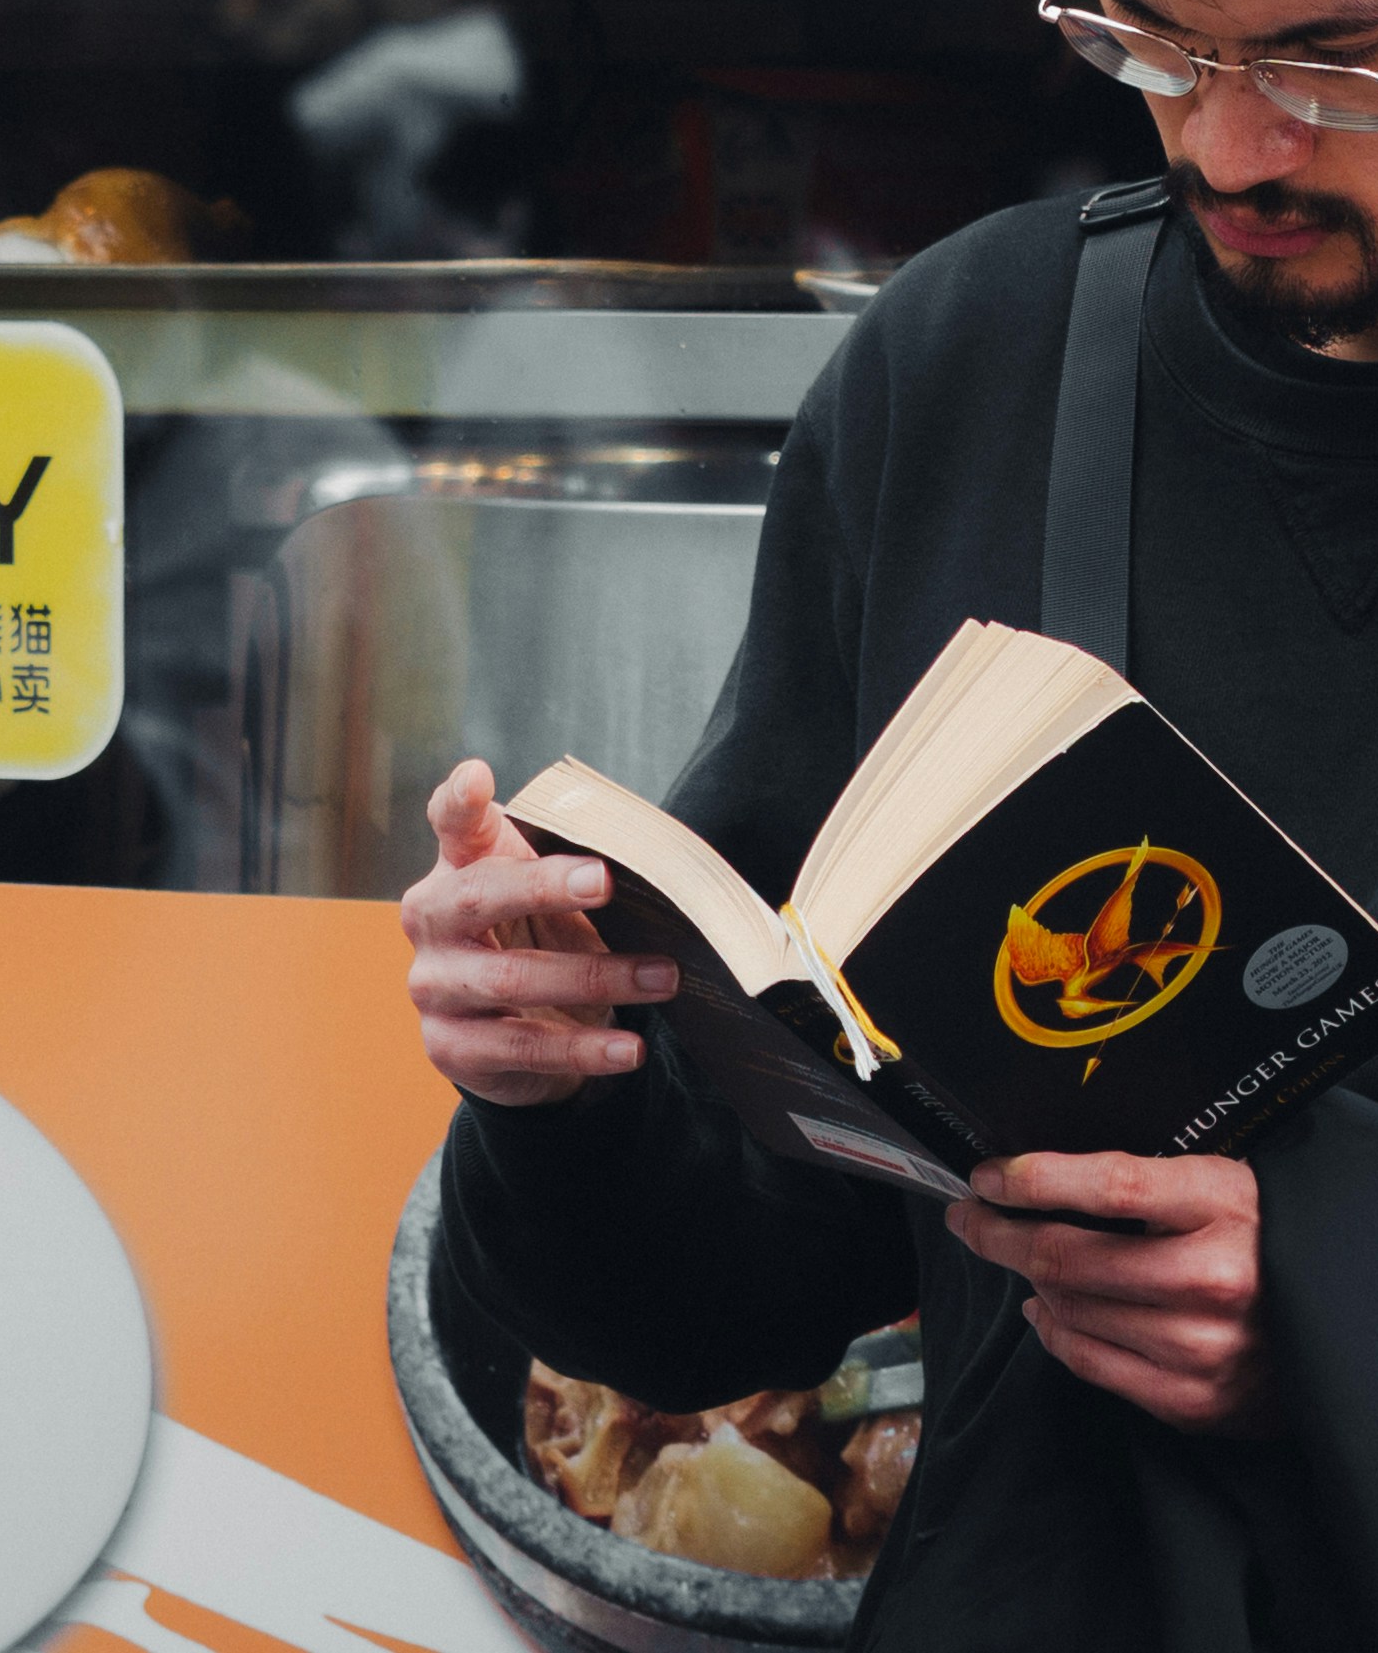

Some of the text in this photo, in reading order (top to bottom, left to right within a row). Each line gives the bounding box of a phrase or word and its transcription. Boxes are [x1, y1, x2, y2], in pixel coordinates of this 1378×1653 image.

[1250, 950, 1284, 978] HUNGER
[1255, 936, 1321, 986] NOW A MAJOR
[1255, 937, 1334, 996] MOTION PICTURE
[1268, 941, 1286, 955] THE
[1272, 977, 1299, 997] March
[1312, 951, 1334, 968] 2012
[1174, 1051, 1298, 1150] HUNGER
